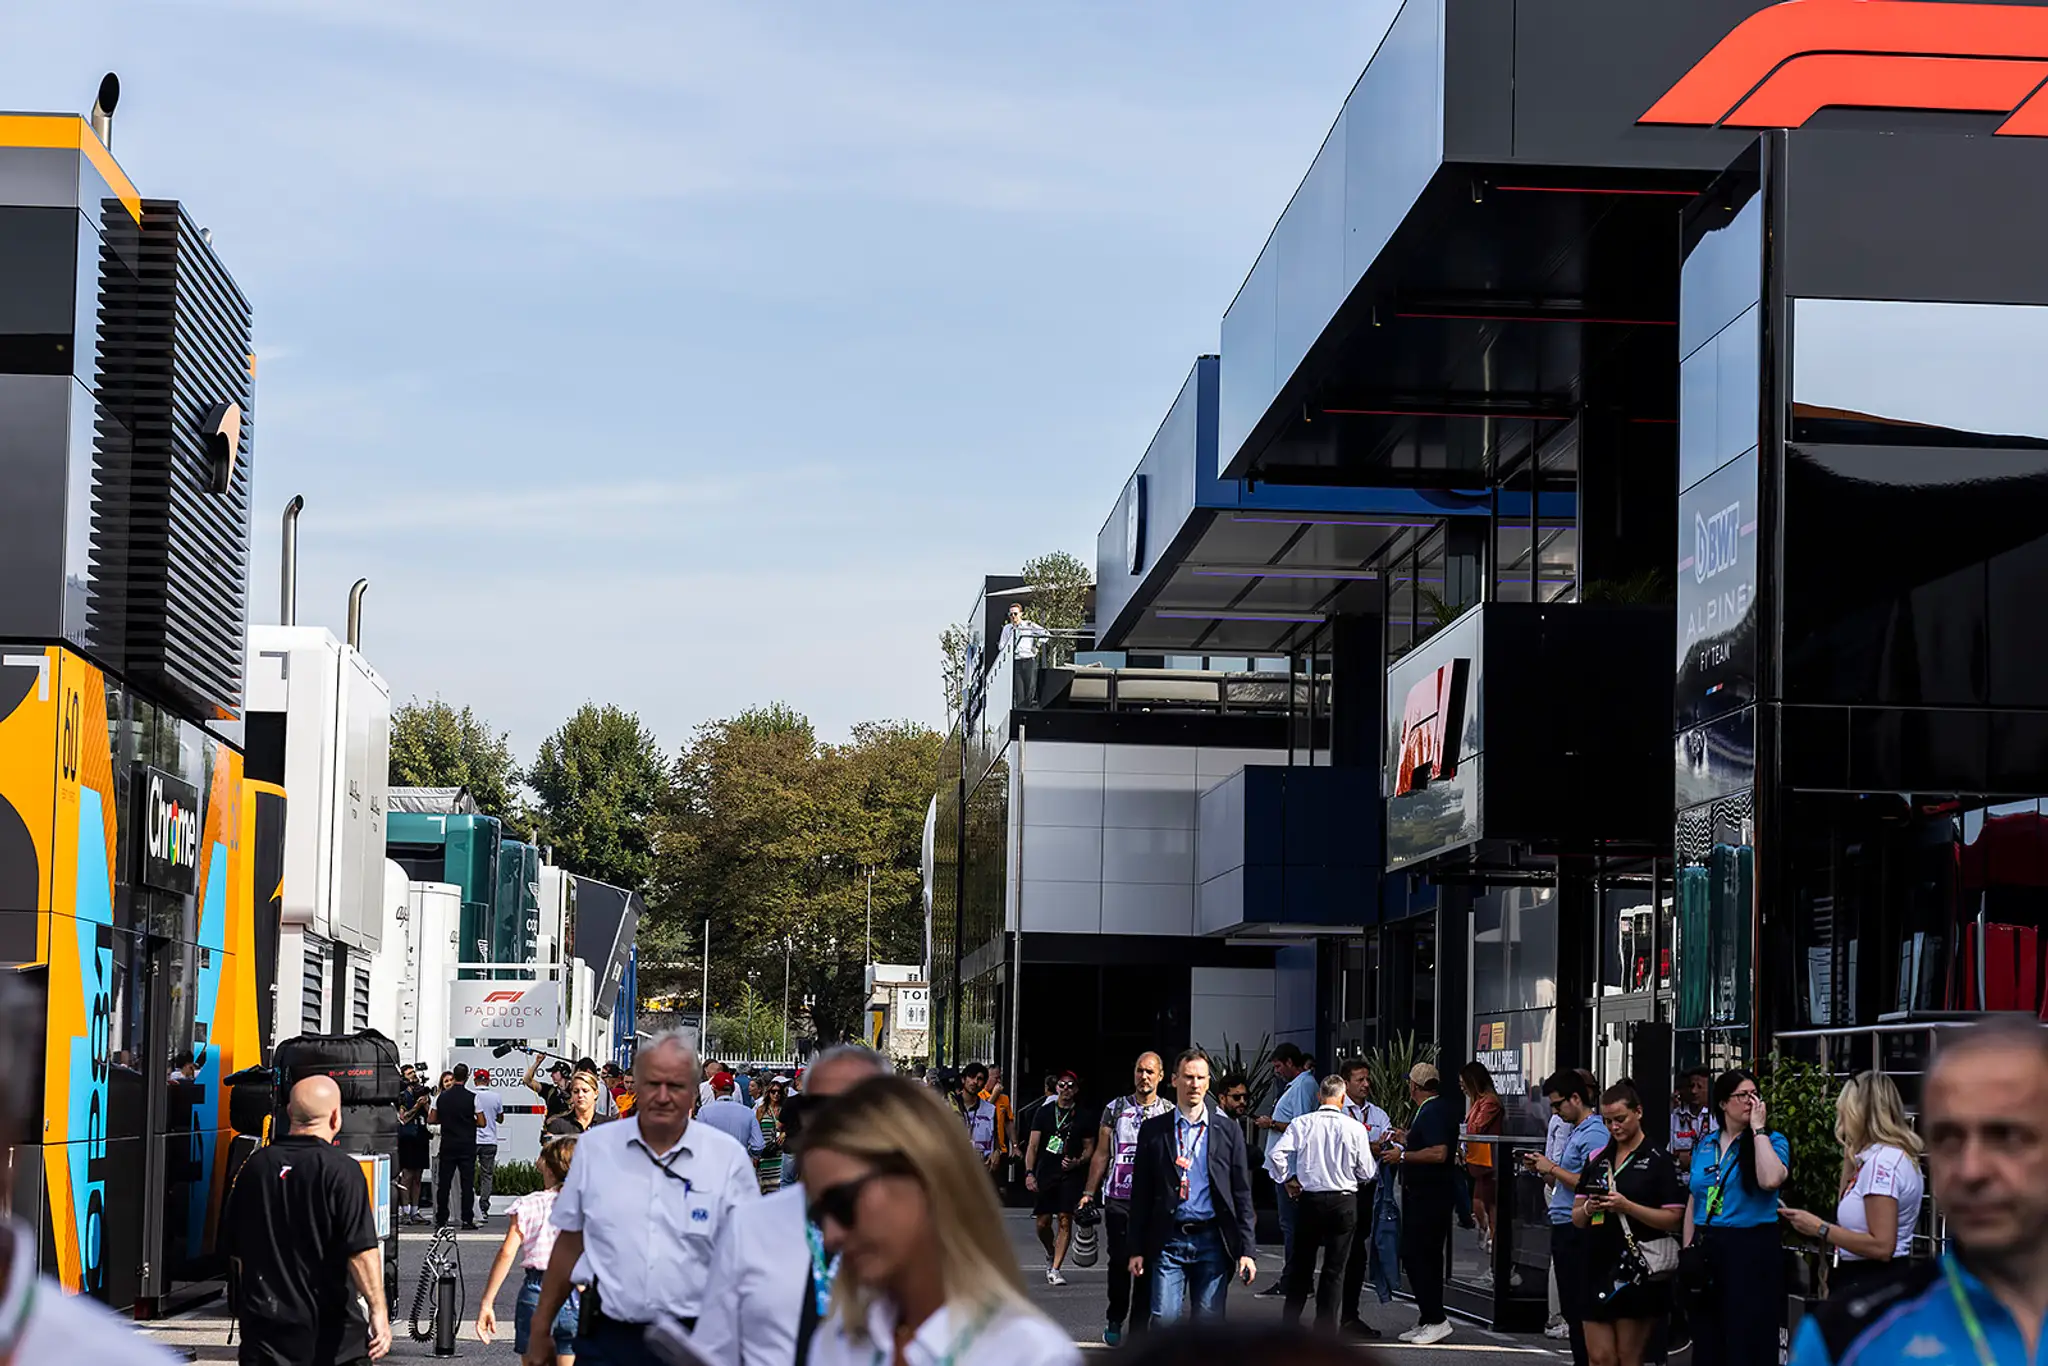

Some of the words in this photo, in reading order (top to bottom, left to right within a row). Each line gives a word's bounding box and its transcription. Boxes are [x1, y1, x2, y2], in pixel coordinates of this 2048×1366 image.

[1707, 501, 1740, 579] BWT
[1686, 583, 1749, 640] ALPINE
[1711, 641, 1731, 667] TEAM
[63, 687, 79, 783] 60
[149, 775, 195, 869] Chrome
[483, 990, 525, 1003] F1
[902, 990, 928, 1000] TOI
[464, 1006, 543, 1017] PADDOCK
[481, 1018, 525, 1028] CLUB
[468, 1067, 524, 1078] COME
[489, 1078, 526, 1088] ONZA
